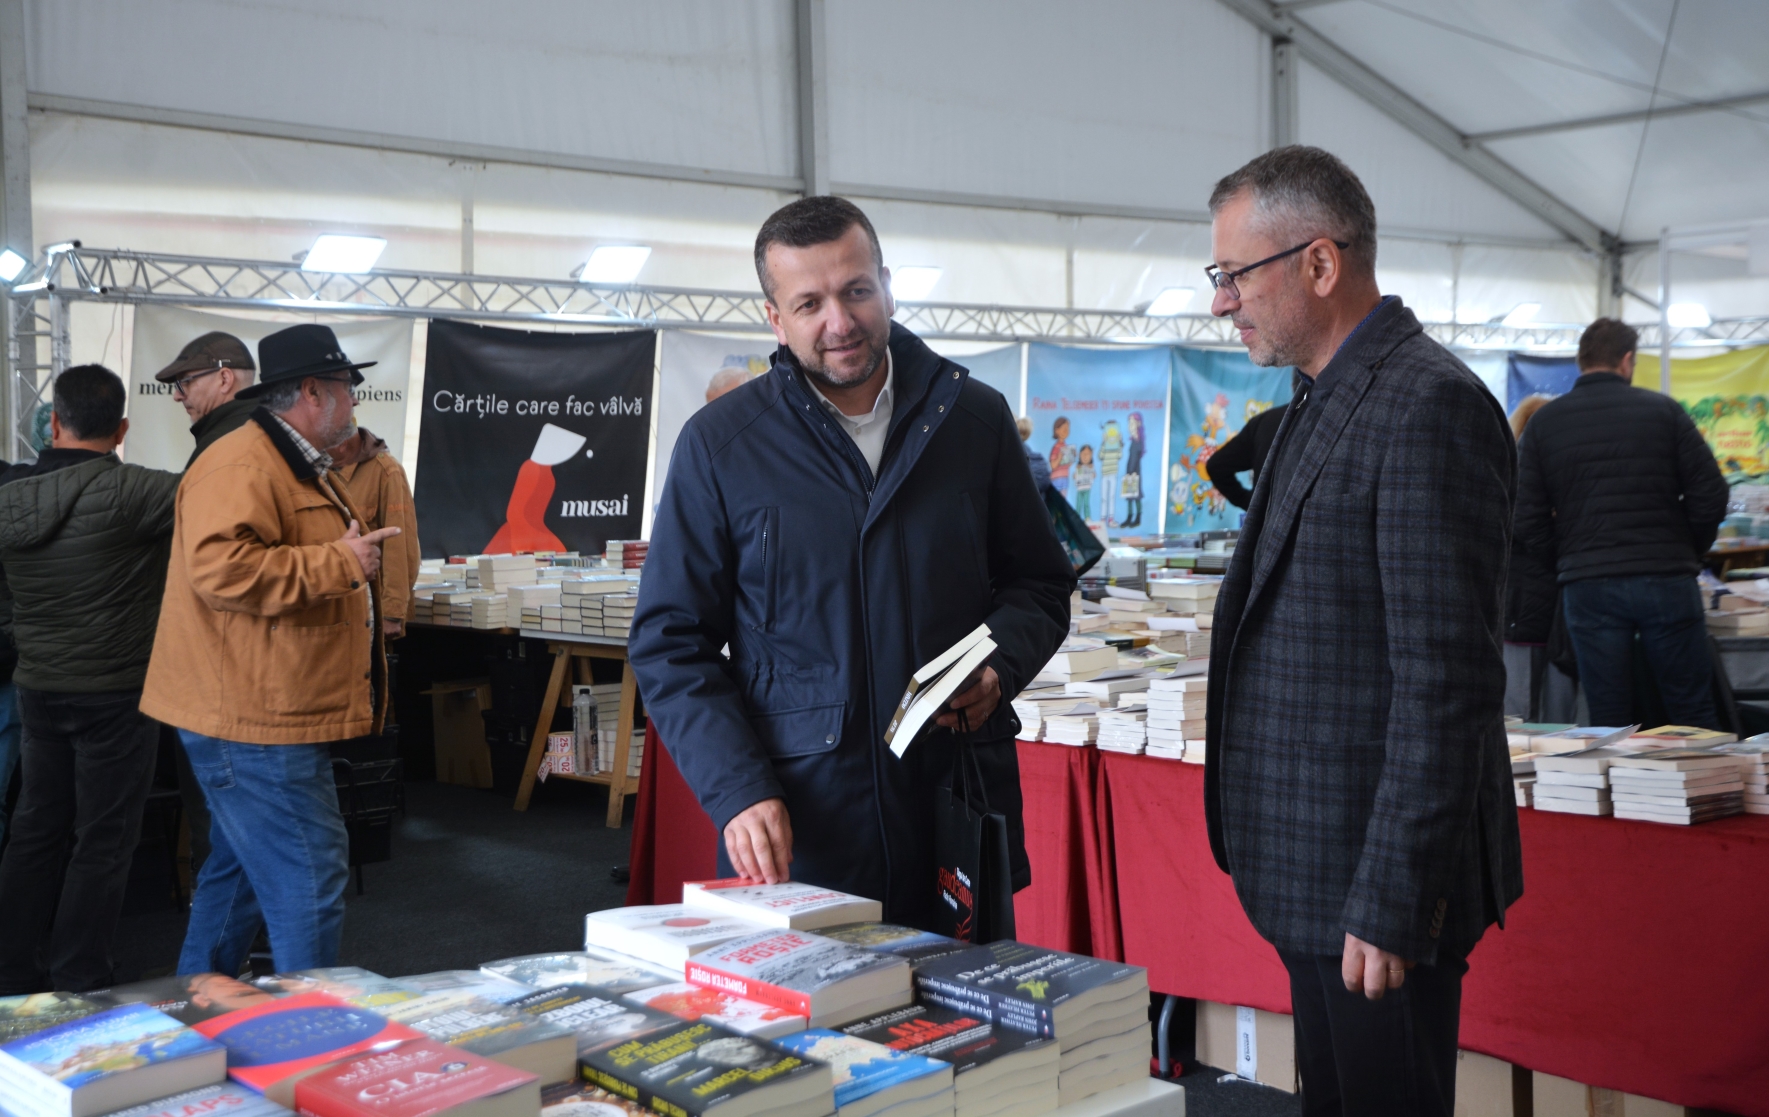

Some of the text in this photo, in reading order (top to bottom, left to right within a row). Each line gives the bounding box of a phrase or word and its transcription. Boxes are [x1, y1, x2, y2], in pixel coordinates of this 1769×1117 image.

[433, 390, 643, 419] Cărțile care fac vâlvă
[560, 494, 629, 518] musai
[539, 997, 613, 1022] ZBOIUL
[358, 1070, 443, 1101] CIA
